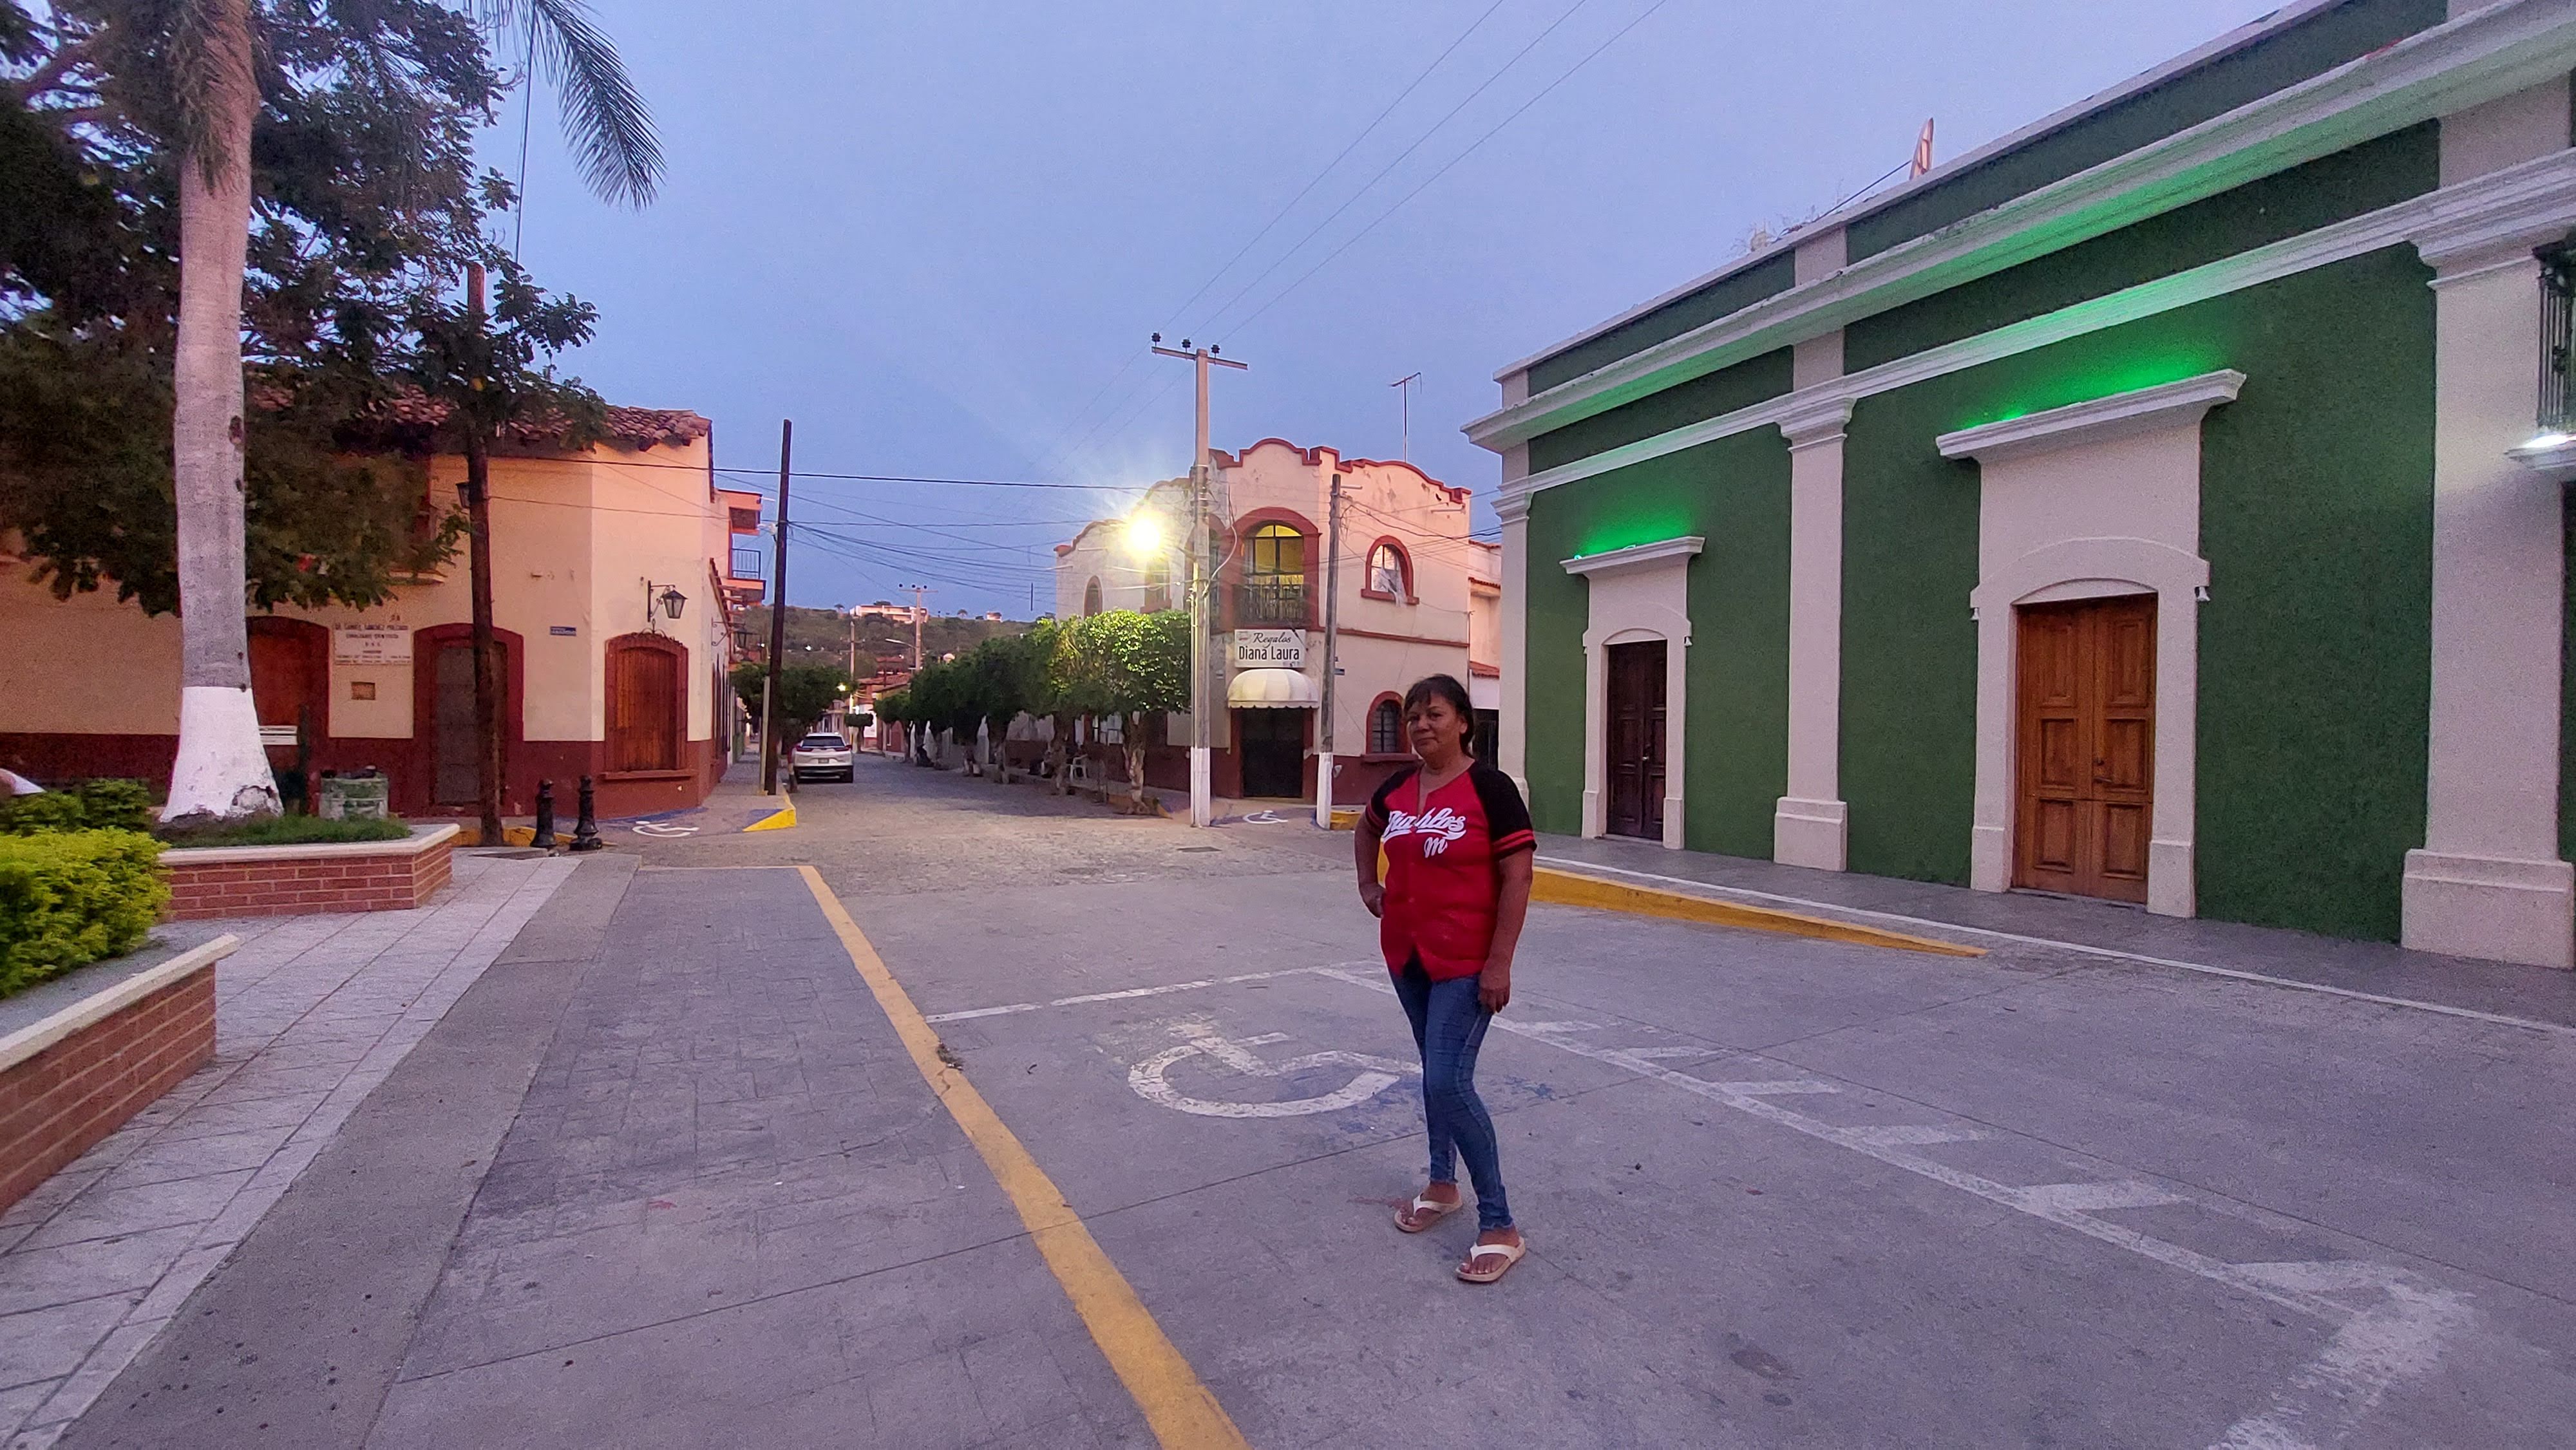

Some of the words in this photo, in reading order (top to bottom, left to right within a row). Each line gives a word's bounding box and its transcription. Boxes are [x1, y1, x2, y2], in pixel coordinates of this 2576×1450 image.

[1253, 632, 1291, 648] Regalos
[1238, 646, 1267, 660] Diana
[1271, 646, 1300, 660] Laura
